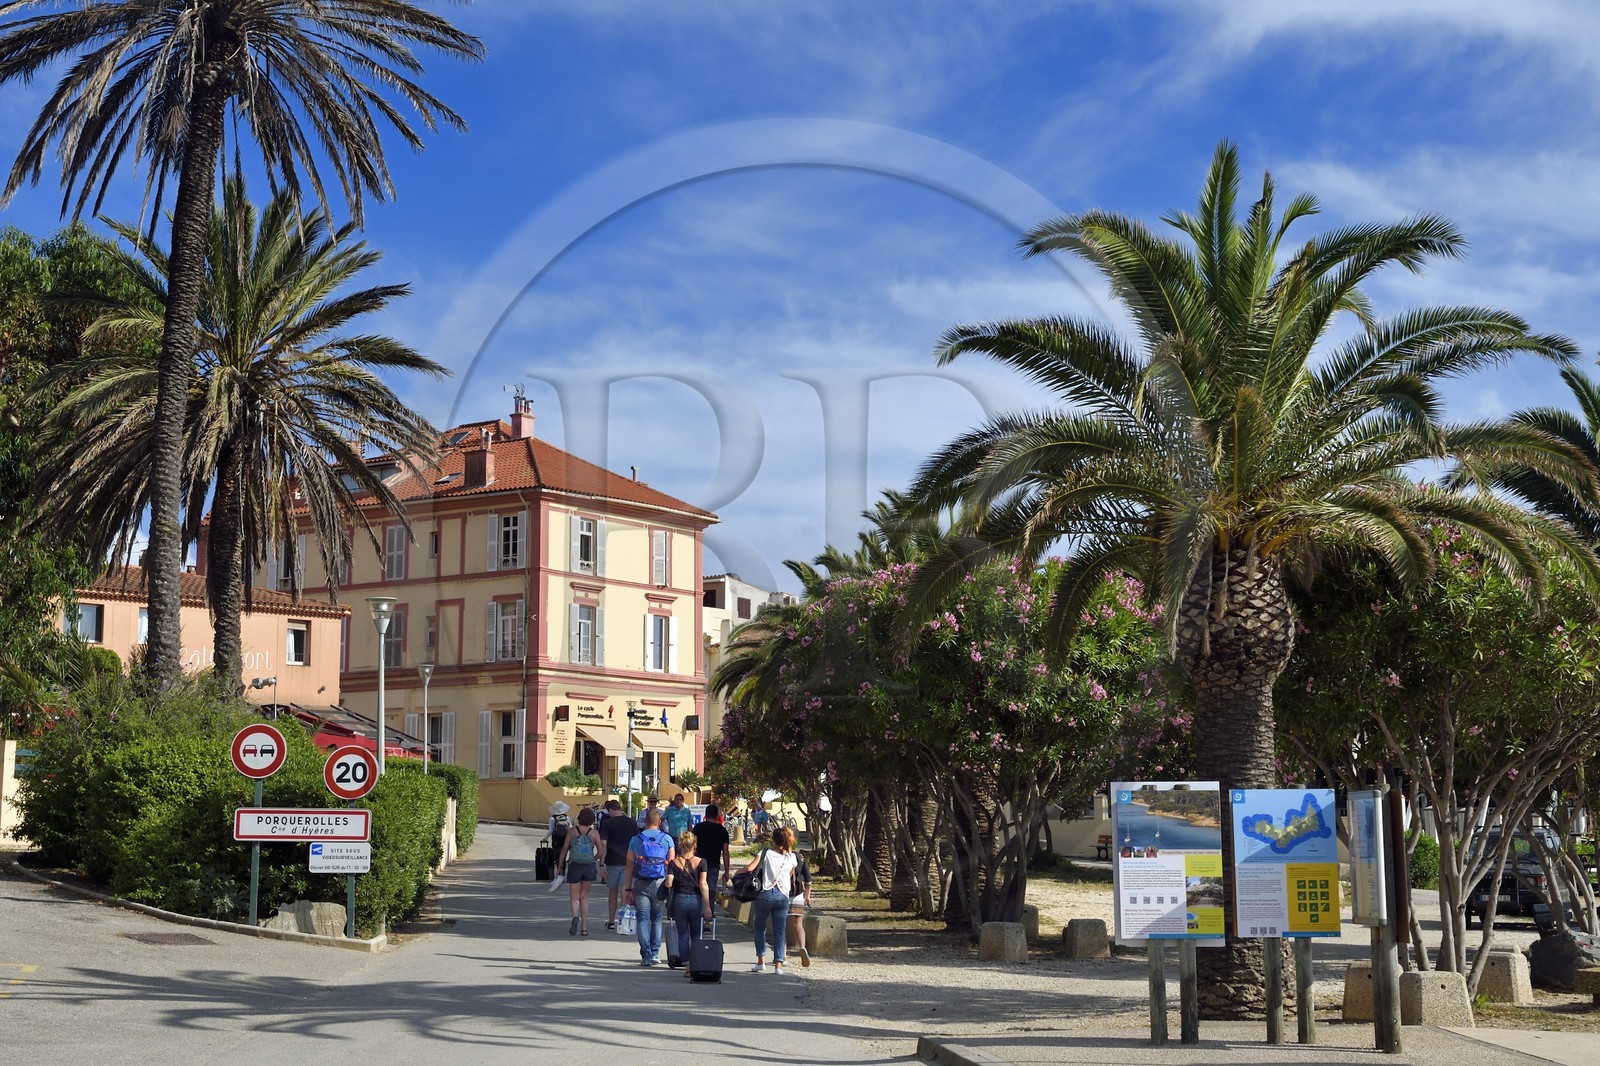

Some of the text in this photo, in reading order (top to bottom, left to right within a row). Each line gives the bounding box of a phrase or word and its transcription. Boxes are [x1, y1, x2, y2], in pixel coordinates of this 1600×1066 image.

[240, 649, 273, 671] ort
[335, 762, 368, 783] 20
[256, 815, 349, 826] PORQUEROLLES
